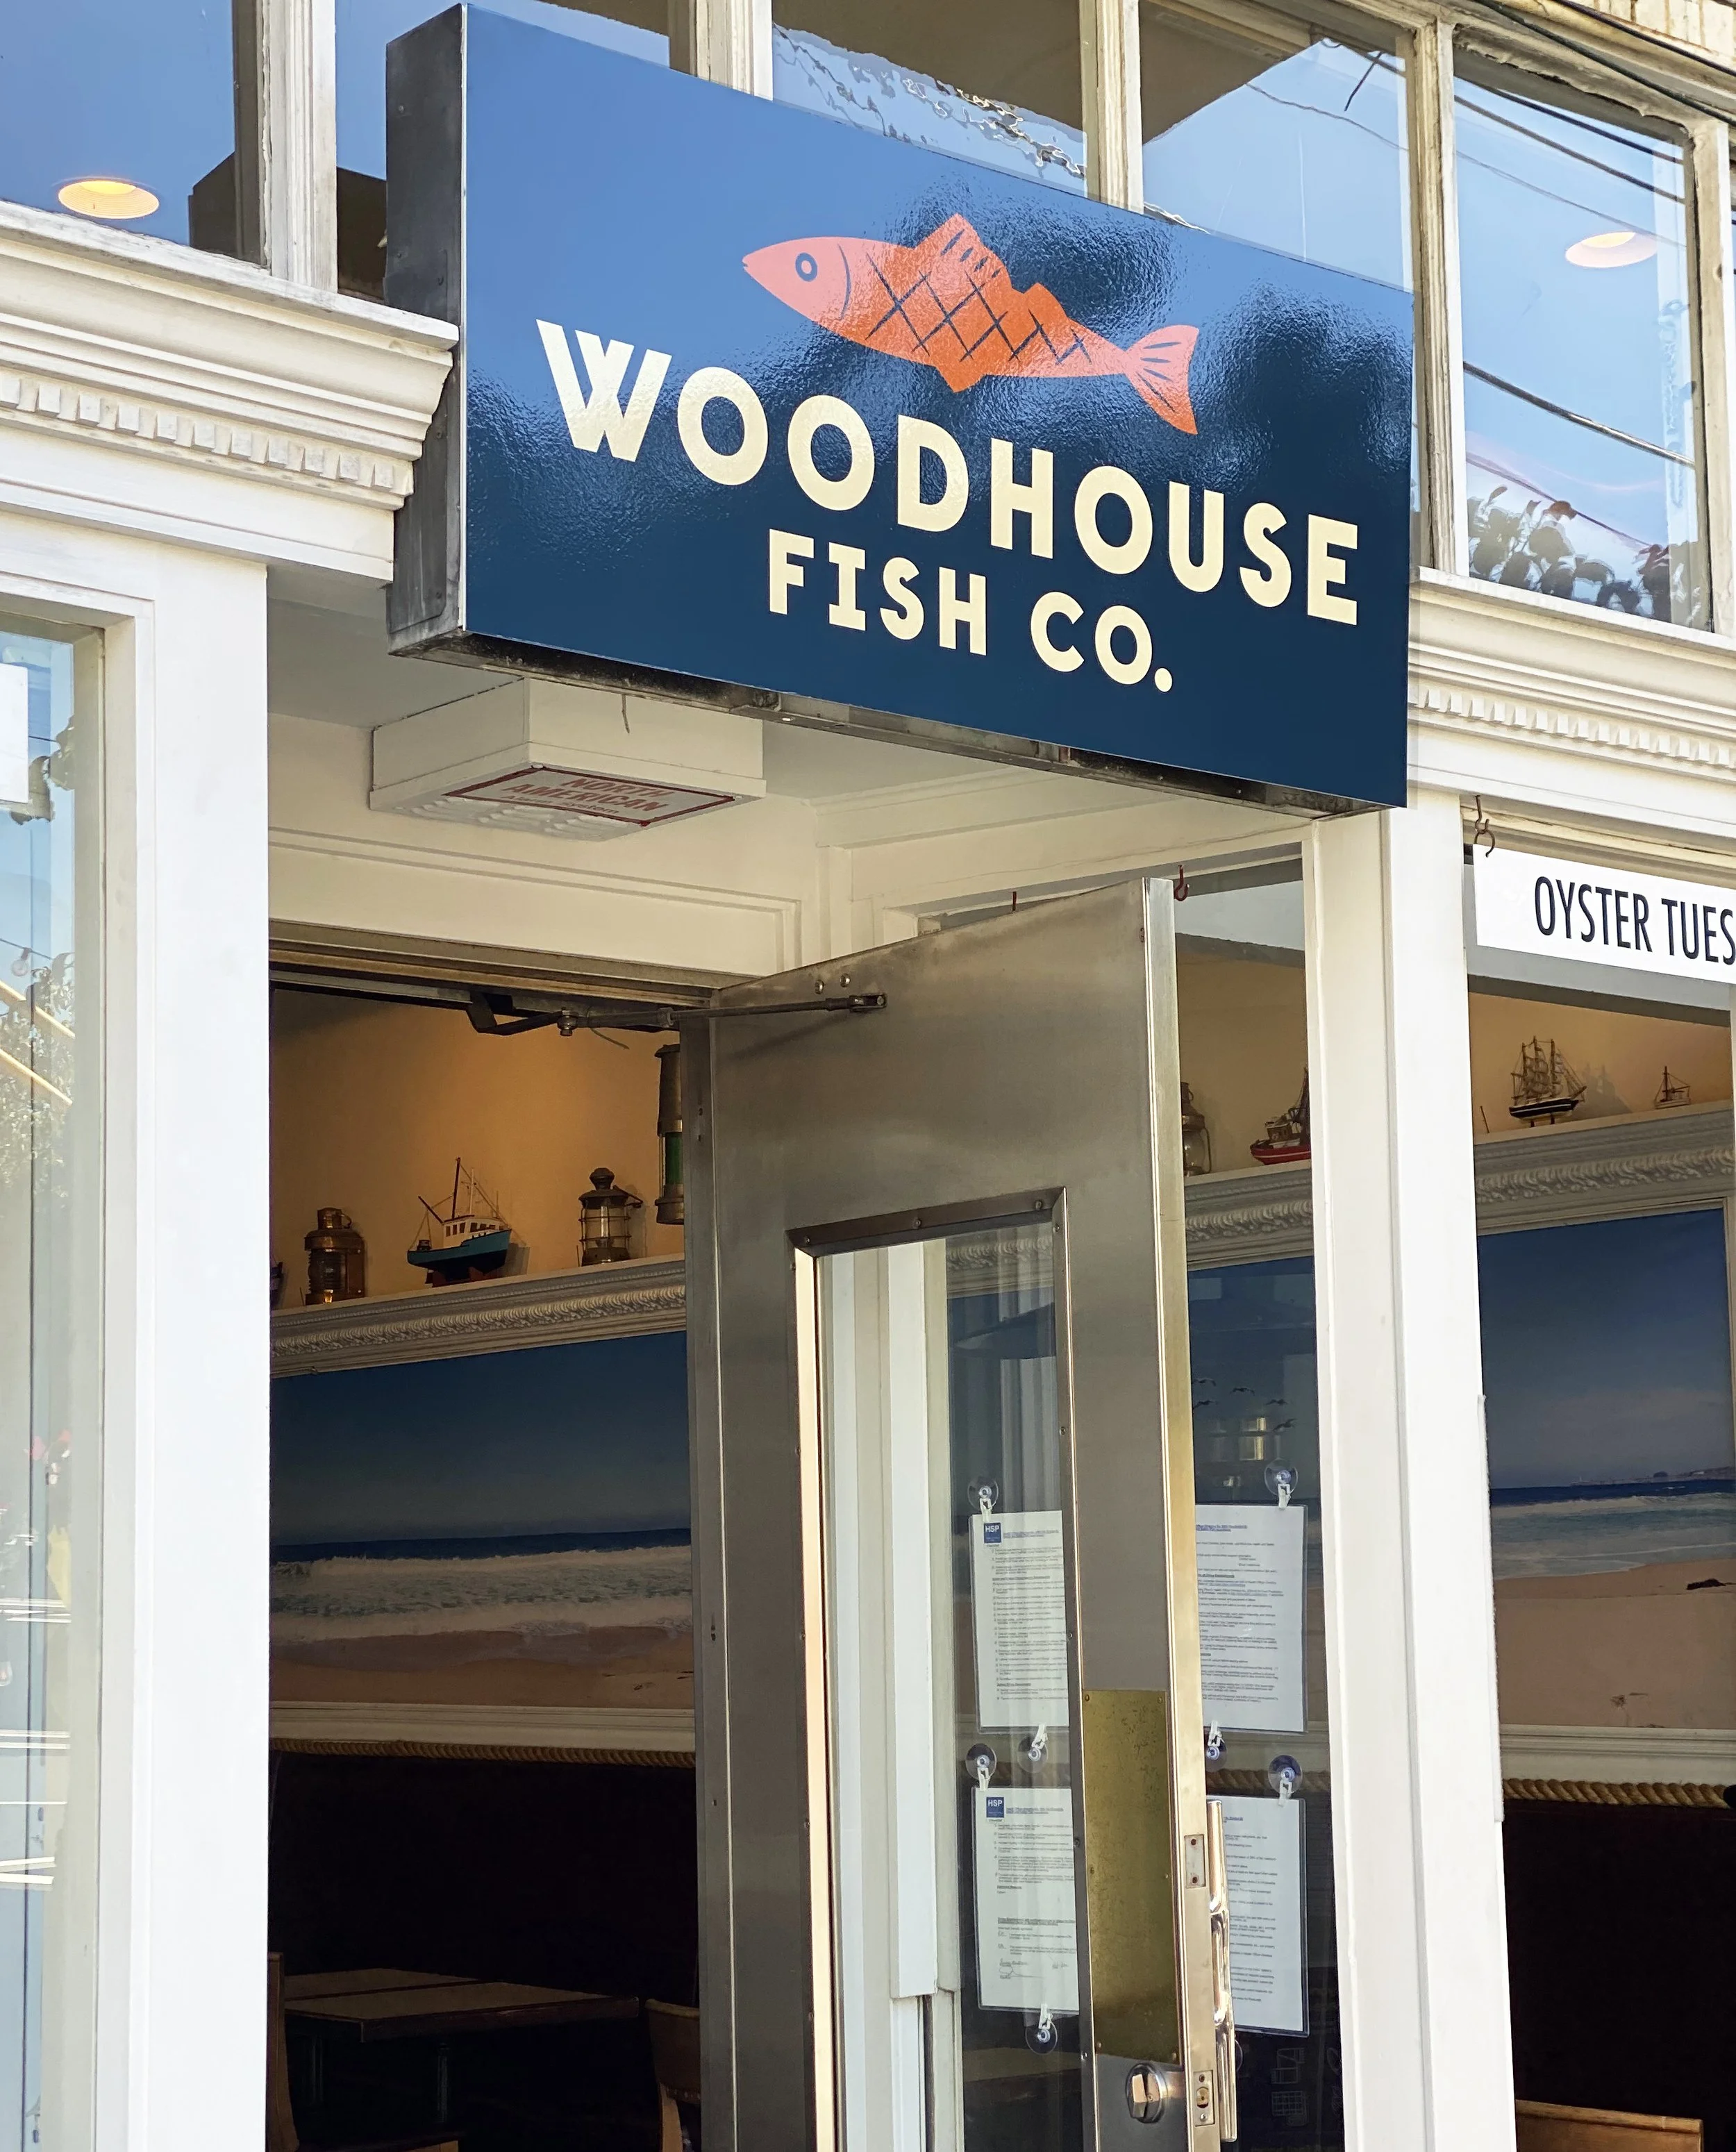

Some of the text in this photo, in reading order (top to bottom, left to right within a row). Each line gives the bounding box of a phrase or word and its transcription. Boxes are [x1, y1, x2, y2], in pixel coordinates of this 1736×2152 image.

[537, 319, 1358, 626] WOODHOUSE
[769, 528, 1174, 692] FISH CO.
[501, 783, 668, 811] AMERICAN
[561, 778, 674, 797] NORTH
[1535, 876, 1736, 965] OYSTER TUES
